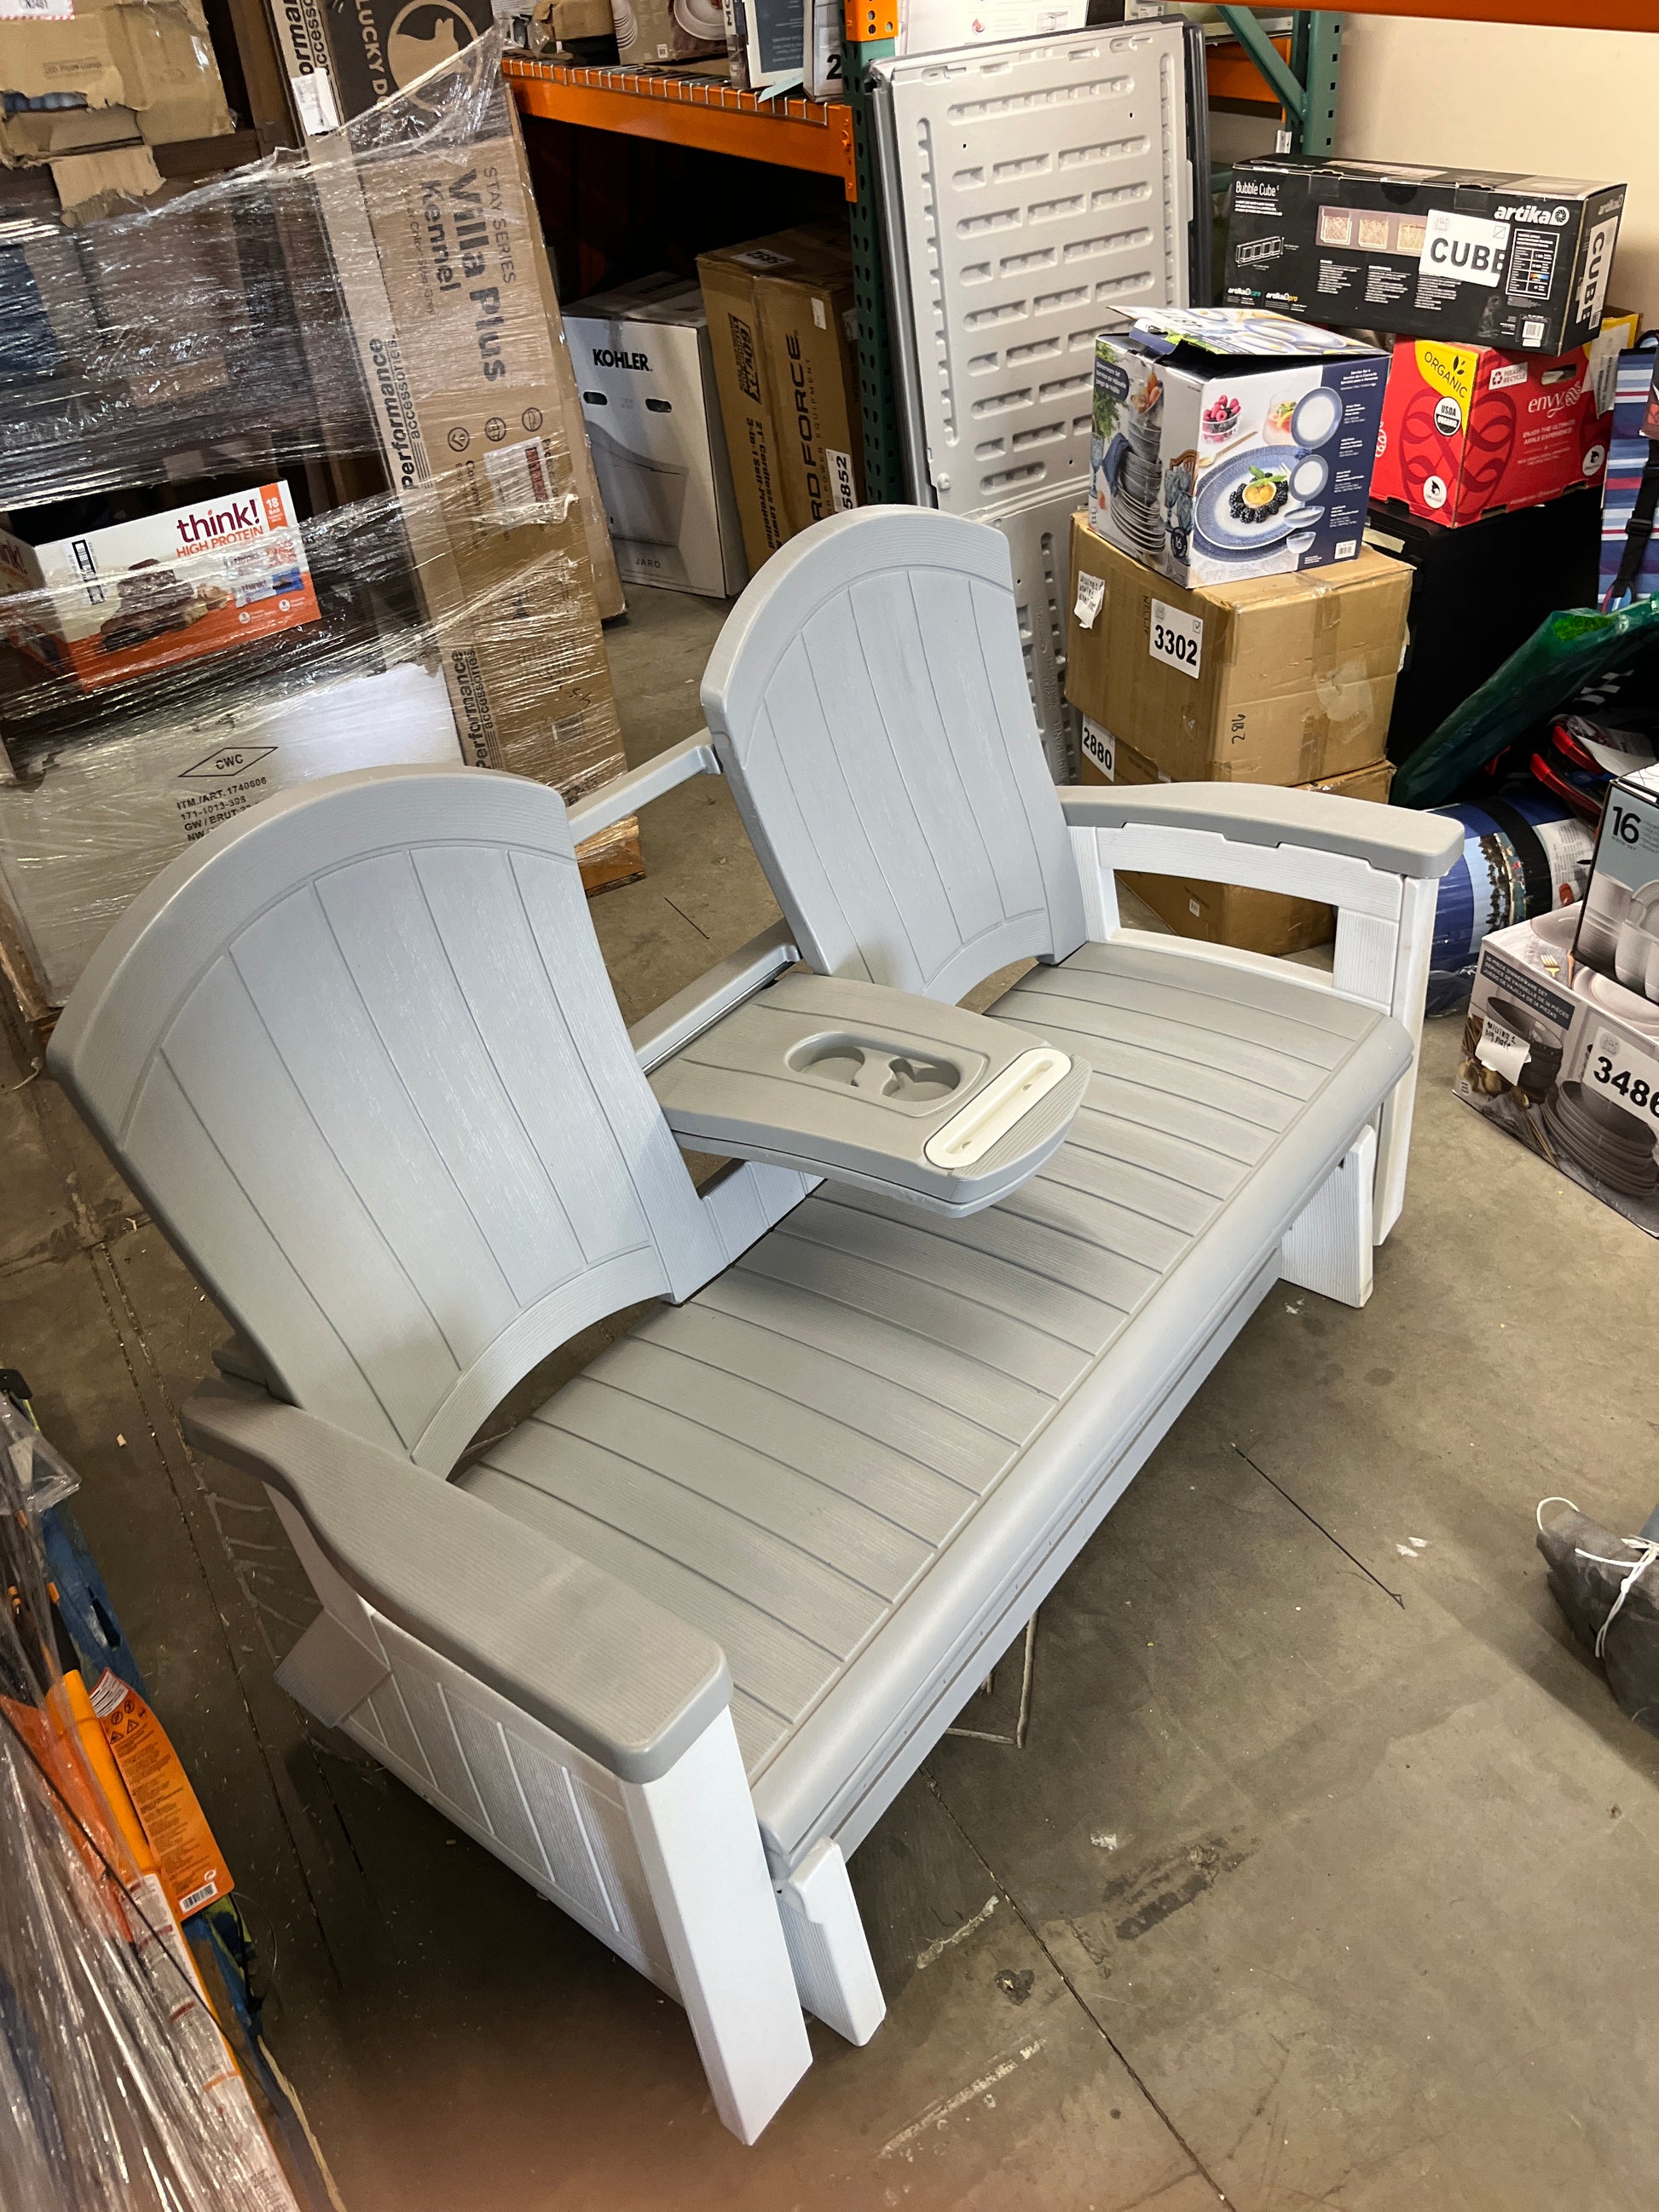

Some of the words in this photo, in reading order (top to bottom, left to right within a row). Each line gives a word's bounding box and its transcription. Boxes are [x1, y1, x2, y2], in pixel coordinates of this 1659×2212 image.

[356, 0, 384, 73] LUCKY
[1235, 181, 1258, 195] Bubble
[1259, 183, 1276, 197] Cube
[421, 180, 461, 292] Kennel
[484, 167, 502, 211] STAY
[493, 218, 516, 284] SERIES
[1494, 205, 1553, 225] artika
[449, 169, 489, 278] Villa
[470, 287, 506, 382] Plus
[1430, 237, 1506, 274] CUBE
[592, 349, 650, 372] KOHLER
[1424, 351, 1468, 398] ORGANIC
[1503, 373, 1526, 383] RECYCLE
[387, 338, 420, 440] accessories
[786, 333, 817, 467] FORCE
[805, 359, 821, 439] EQUIPMENT
[1441, 405, 1456, 417] USDA
[1528, 391, 1564, 419] envy
[369, 338, 417, 490] performance
[1523, 429, 1540, 439] ENJOY
[760, 444, 773, 503] Cordless
[769, 505, 781, 538] Lawn
[818, 447, 830, 497] POWER
[836, 455, 853, 511] 5852
[176, 499, 260, 544] think!
[265, 497, 280, 510] 18
[754, 457, 775, 551] Self-Propelled
[176, 540, 209, 557] HIGH
[211, 526, 264, 549] PROTEIN
[635, 558, 661, 569] JARO
[1154, 625, 1198, 667] 3302
[466, 650, 494, 729] accessories
[215, 754, 244, 770] CWC
[1084, 726, 1113, 771] 2880
[184, 820, 202, 831] GW
[1612, 806, 1642, 844] 16
[1537, 989, 1548, 997] SET
